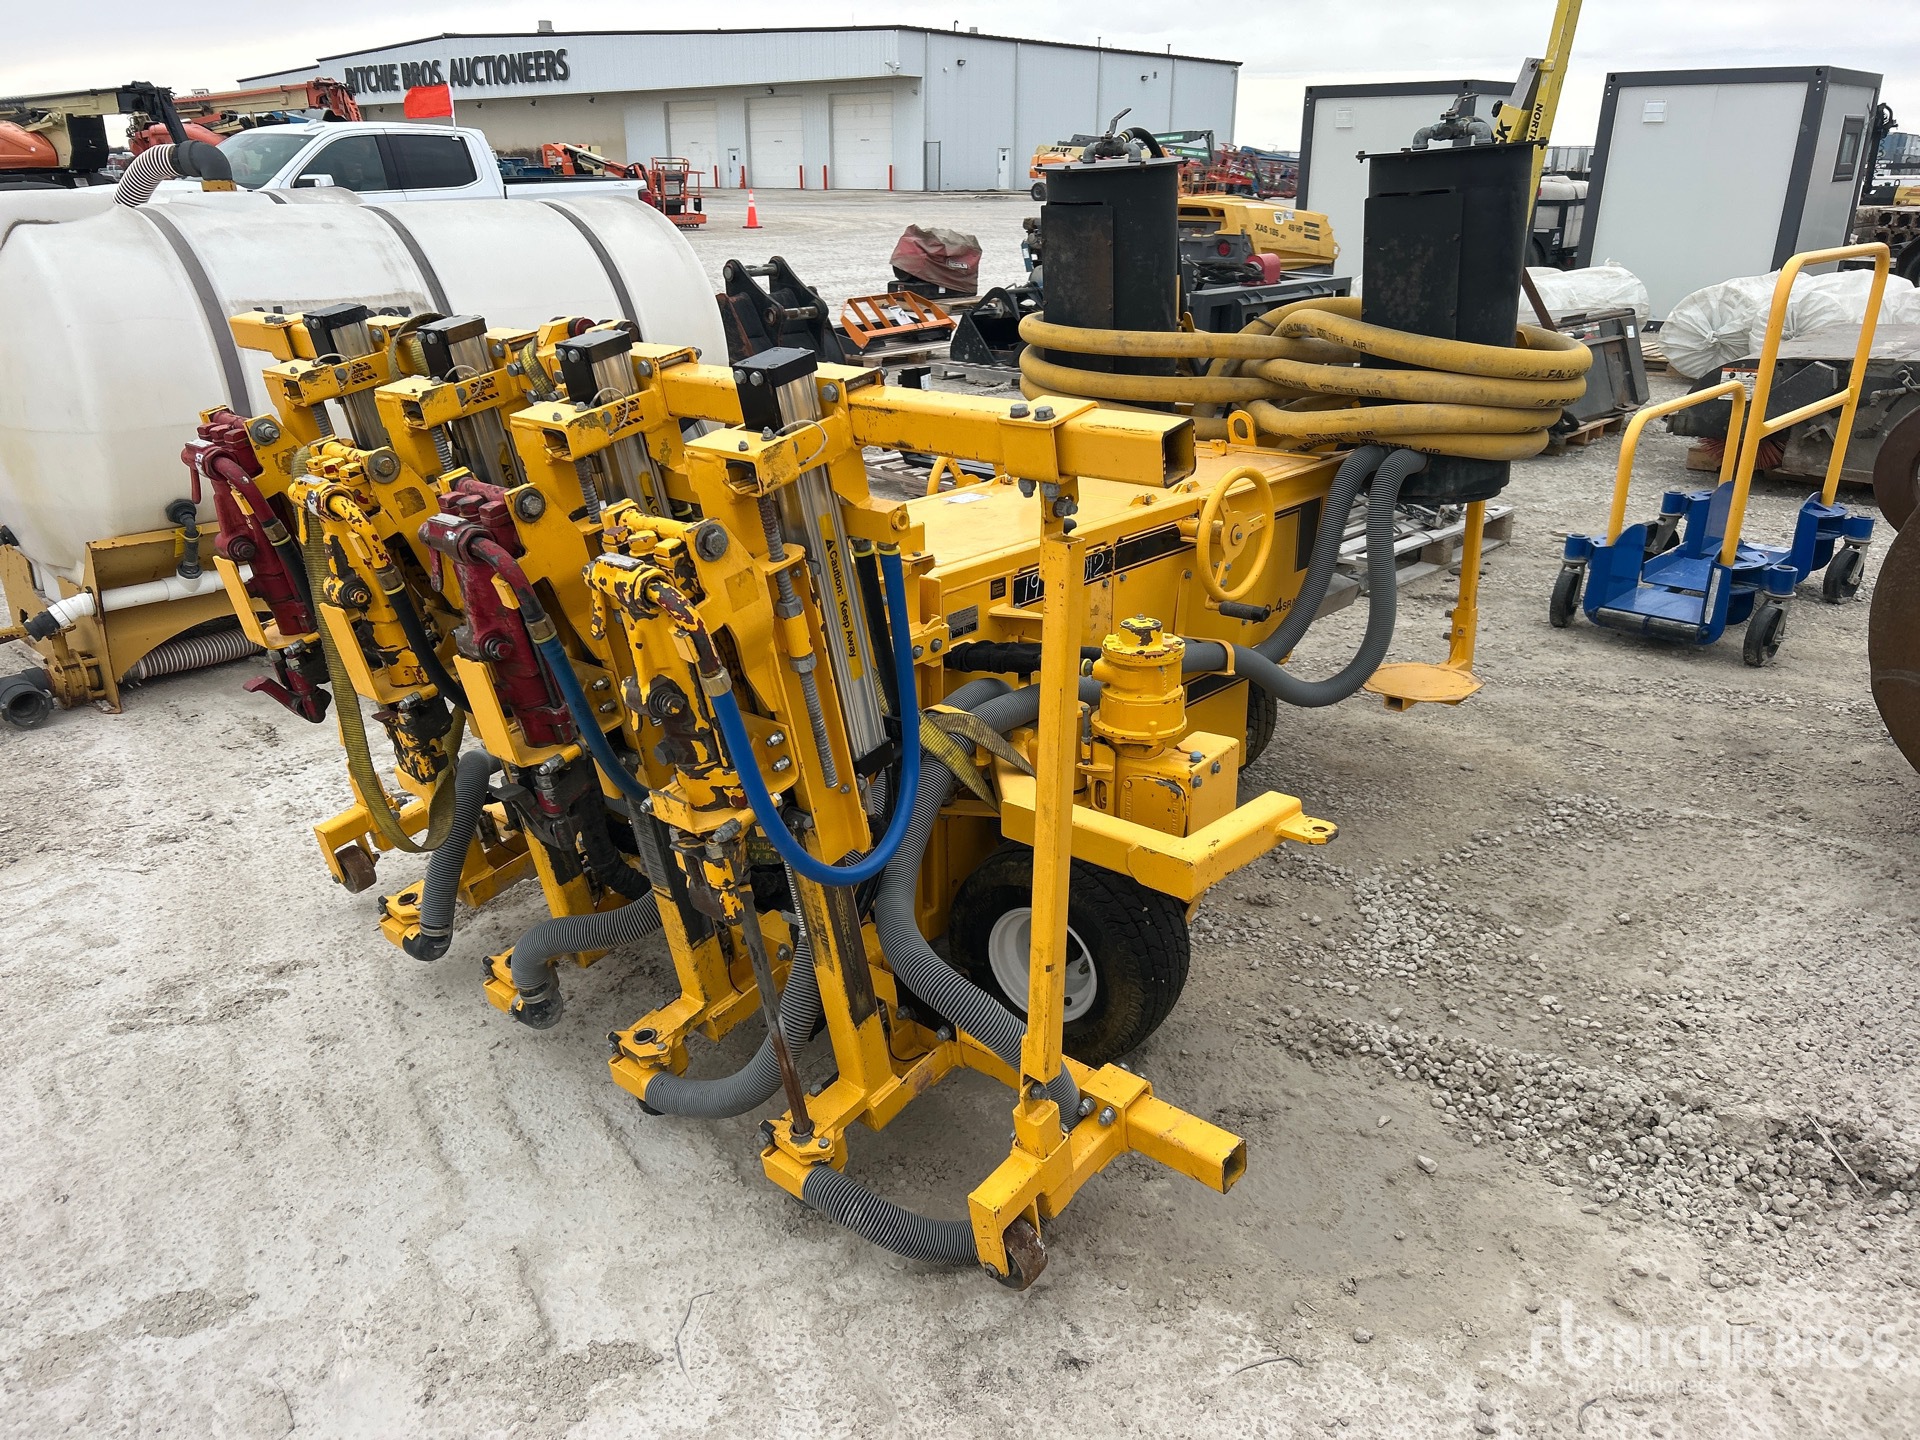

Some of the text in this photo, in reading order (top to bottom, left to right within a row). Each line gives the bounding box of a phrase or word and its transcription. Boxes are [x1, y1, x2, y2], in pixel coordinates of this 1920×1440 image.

[344, 63, 401, 95] RITCHIE
[450, 48, 570, 88] AUCTIONEERS
[1254, 222, 1268, 234] XAS
[1356, 429, 1375, 437] AIR
[829, 550, 857, 658] Caution: Keep Away
